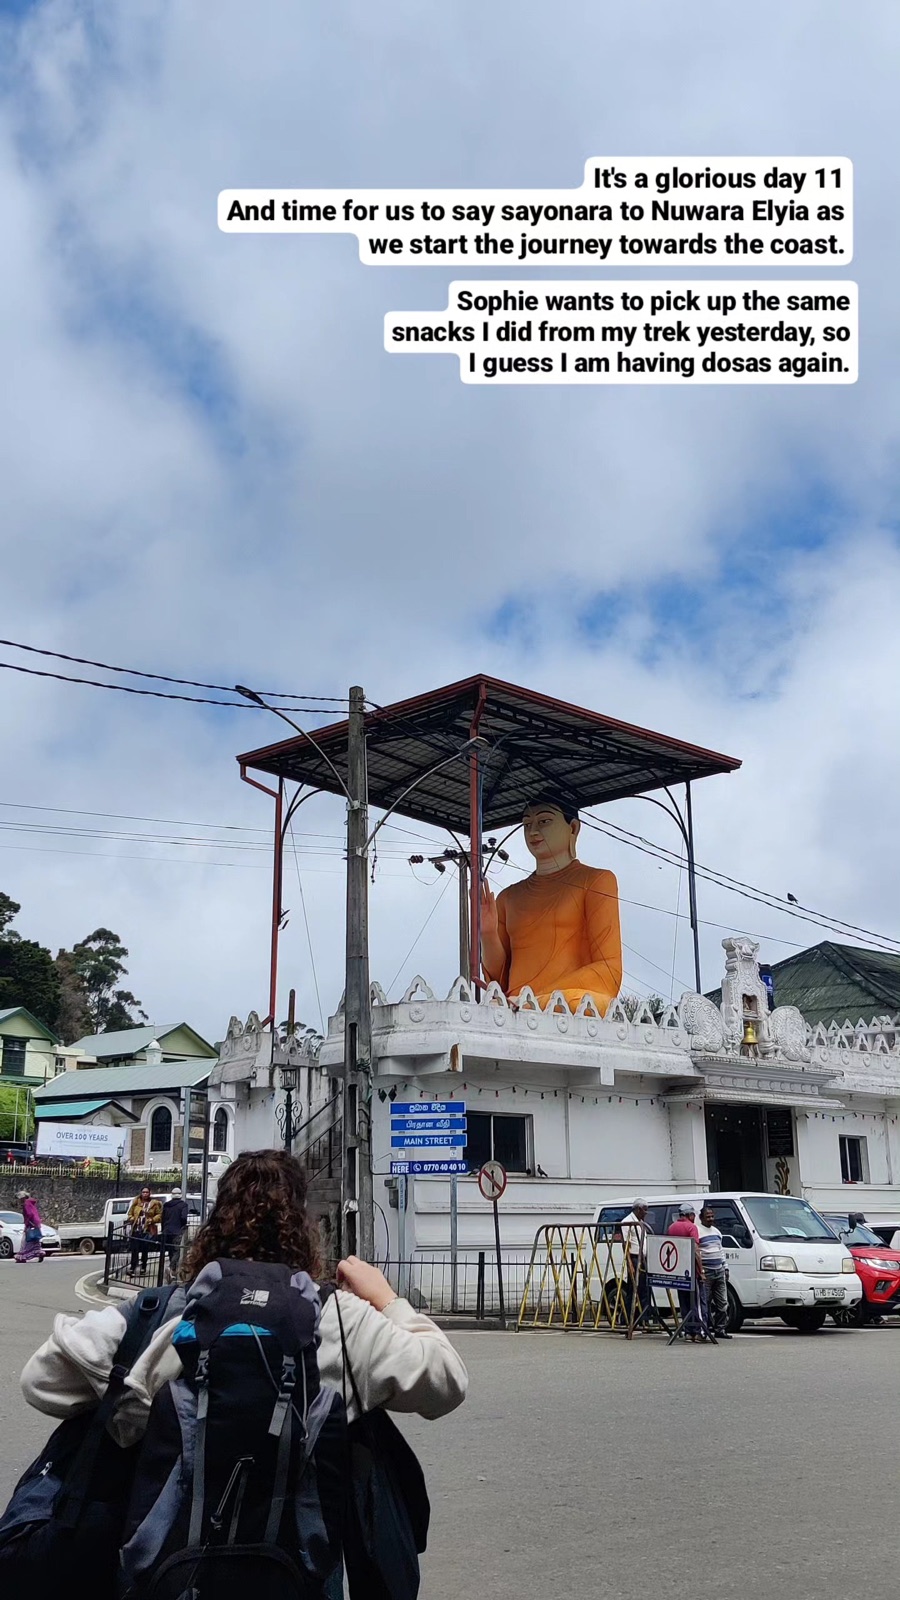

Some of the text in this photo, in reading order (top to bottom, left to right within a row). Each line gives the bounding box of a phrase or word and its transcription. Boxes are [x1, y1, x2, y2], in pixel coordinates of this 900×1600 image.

[56, 1131, 109, 1142] OVER 100 YEARS
[404, 1137, 454, 1146] MAIN STREET
[392, 1165, 410, 1174] HERE
[423, 1163, 440, 1172] 0770
[440, 1163, 448, 1171] 40
[449, 1163, 457, 1171] 40
